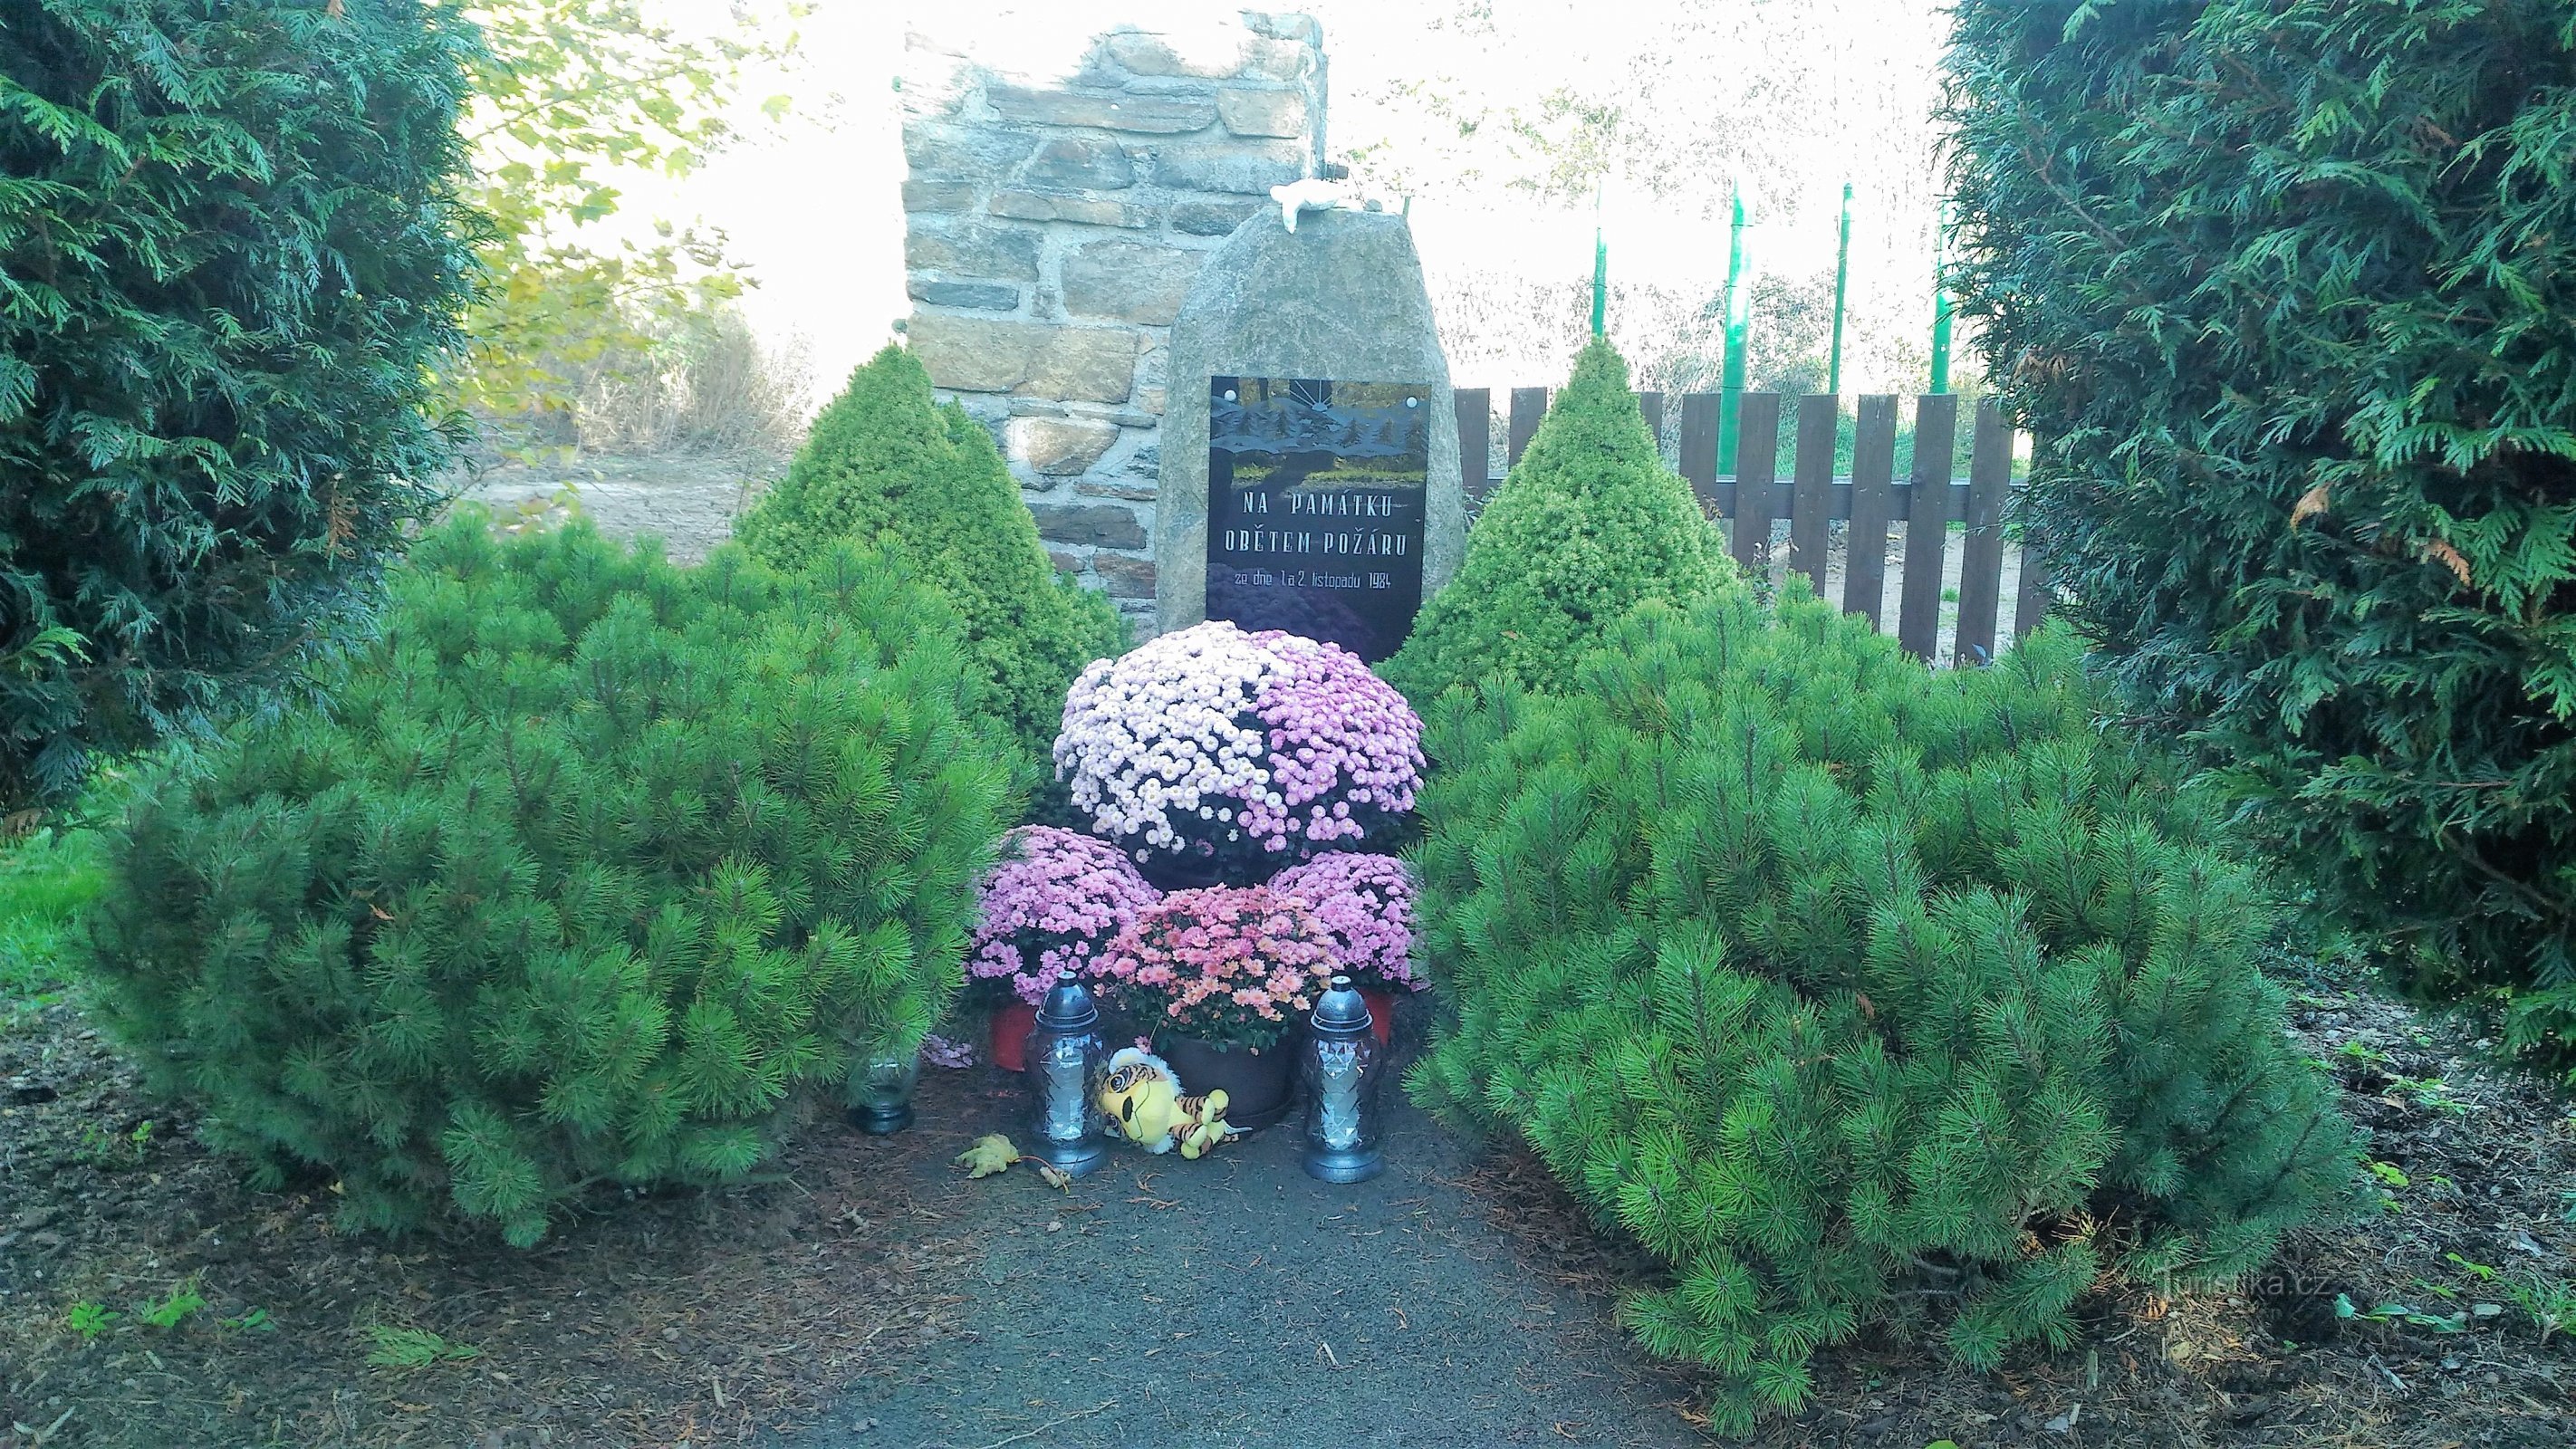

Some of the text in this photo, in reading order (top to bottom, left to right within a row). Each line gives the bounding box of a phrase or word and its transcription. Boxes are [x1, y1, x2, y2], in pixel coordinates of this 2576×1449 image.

[1242, 489, 1392, 517] NA PAMÁTKU
[1225, 523, 1407, 556] OBĚTEM POŽÁRU
[1235, 572, 1248, 585] ze
[1253, 570, 1273, 586] dne
[1312, 571, 1361, 589] listopadu
[1368, 571, 1391, 589] 1984
